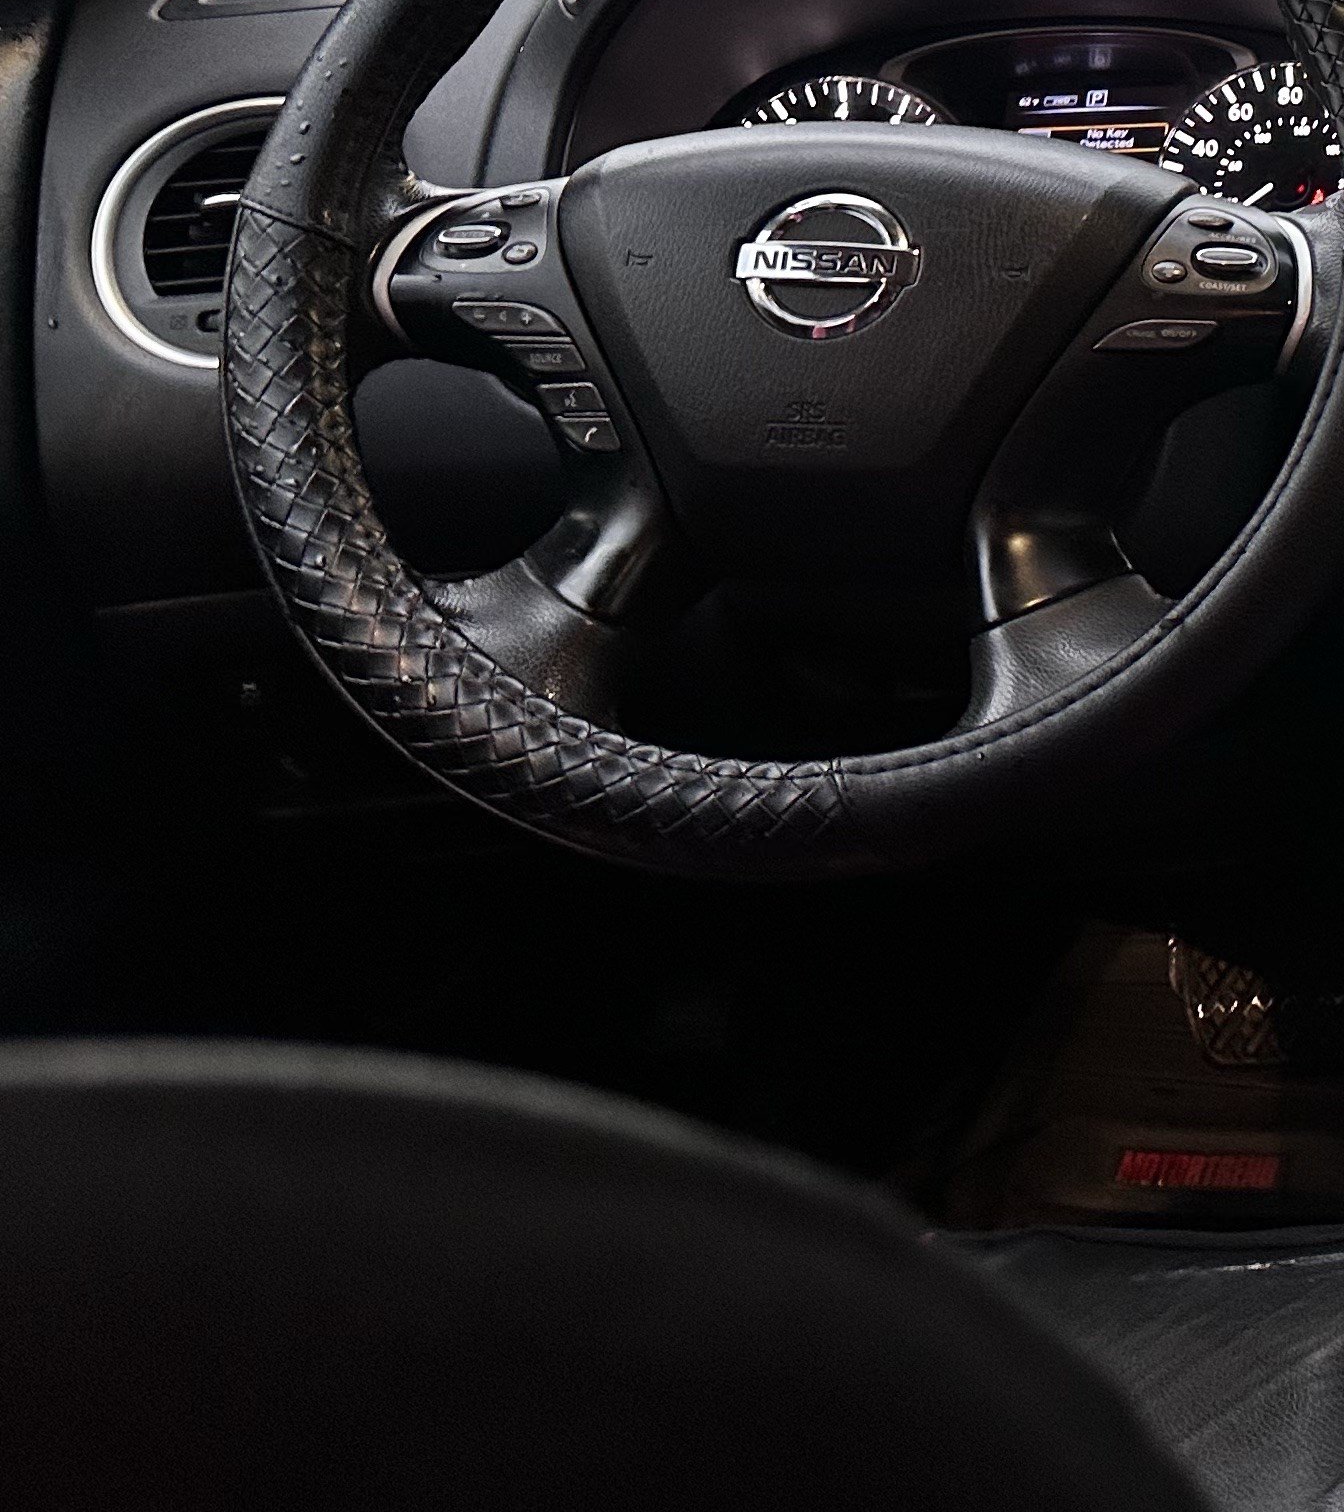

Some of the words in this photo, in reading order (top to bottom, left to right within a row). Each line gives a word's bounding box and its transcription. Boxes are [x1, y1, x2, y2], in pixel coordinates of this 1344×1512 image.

[1277, 86, 1304, 105] 80
[833, 101, 850, 120] 4
[1227, 102, 1254, 121] 60
[1087, 129, 1103, 139] No
[1106, 128, 1129, 139] Key
[1192, 138, 1219, 157] 40
[754, 249, 897, 277] NISSAN
[1199, 281, 1247, 292] COAST/SET
